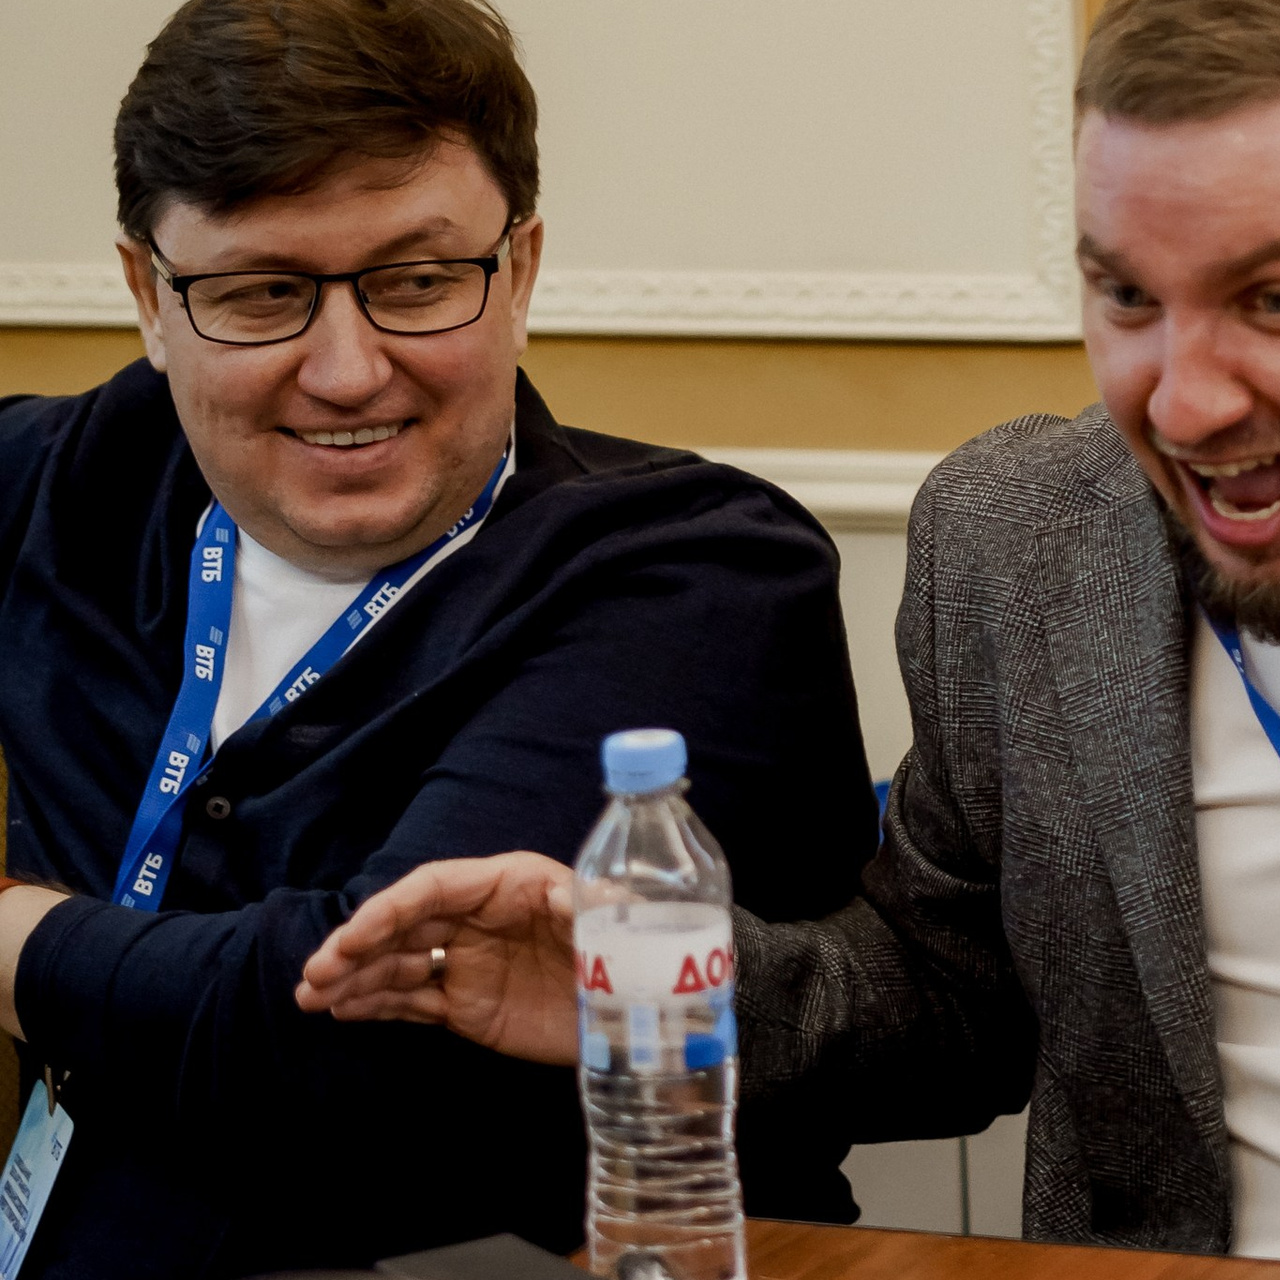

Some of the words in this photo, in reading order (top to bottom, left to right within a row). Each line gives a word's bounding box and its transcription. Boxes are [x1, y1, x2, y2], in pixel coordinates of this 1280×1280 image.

[202, 546, 223, 583] ВТБ
[363, 581, 401, 619] ВТБ
[195, 644, 215, 682] ВТБ
[159, 750, 190, 795] ВТБ
[132, 852, 164, 896] ВТБ
